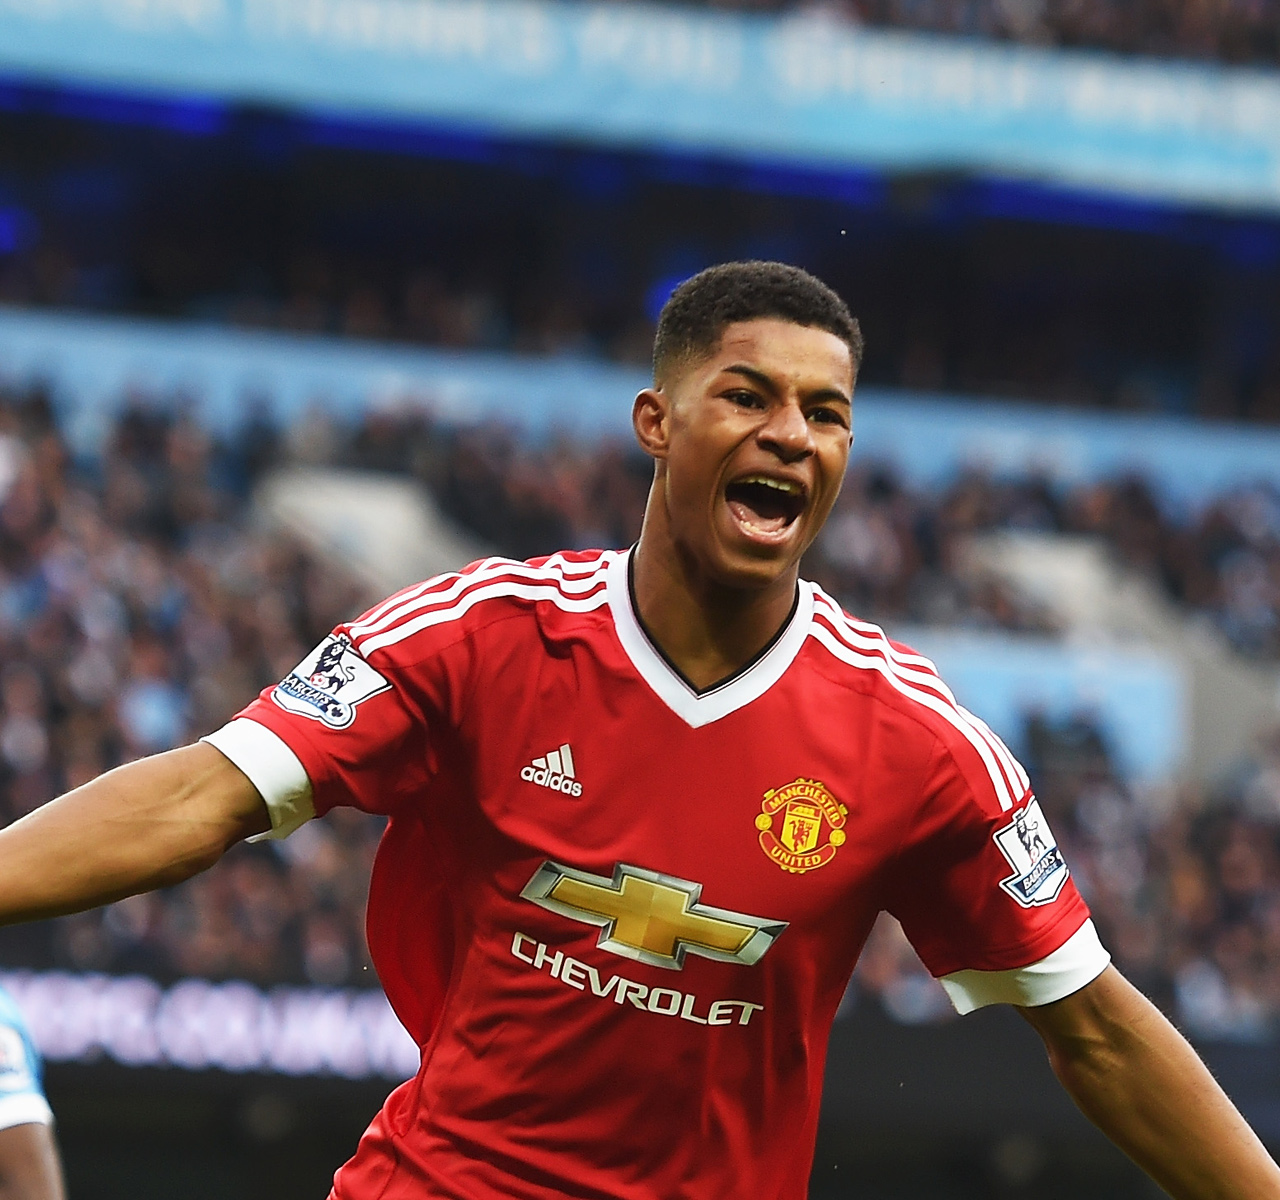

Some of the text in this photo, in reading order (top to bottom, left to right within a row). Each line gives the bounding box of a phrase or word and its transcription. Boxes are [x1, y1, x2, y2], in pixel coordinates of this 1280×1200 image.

[520, 766, 583, 797] adidas
[768, 785, 841, 823] MANCHESTER
[770, 845, 822, 868] UNITED
[511, 931, 764, 1026] CHEVROLET
